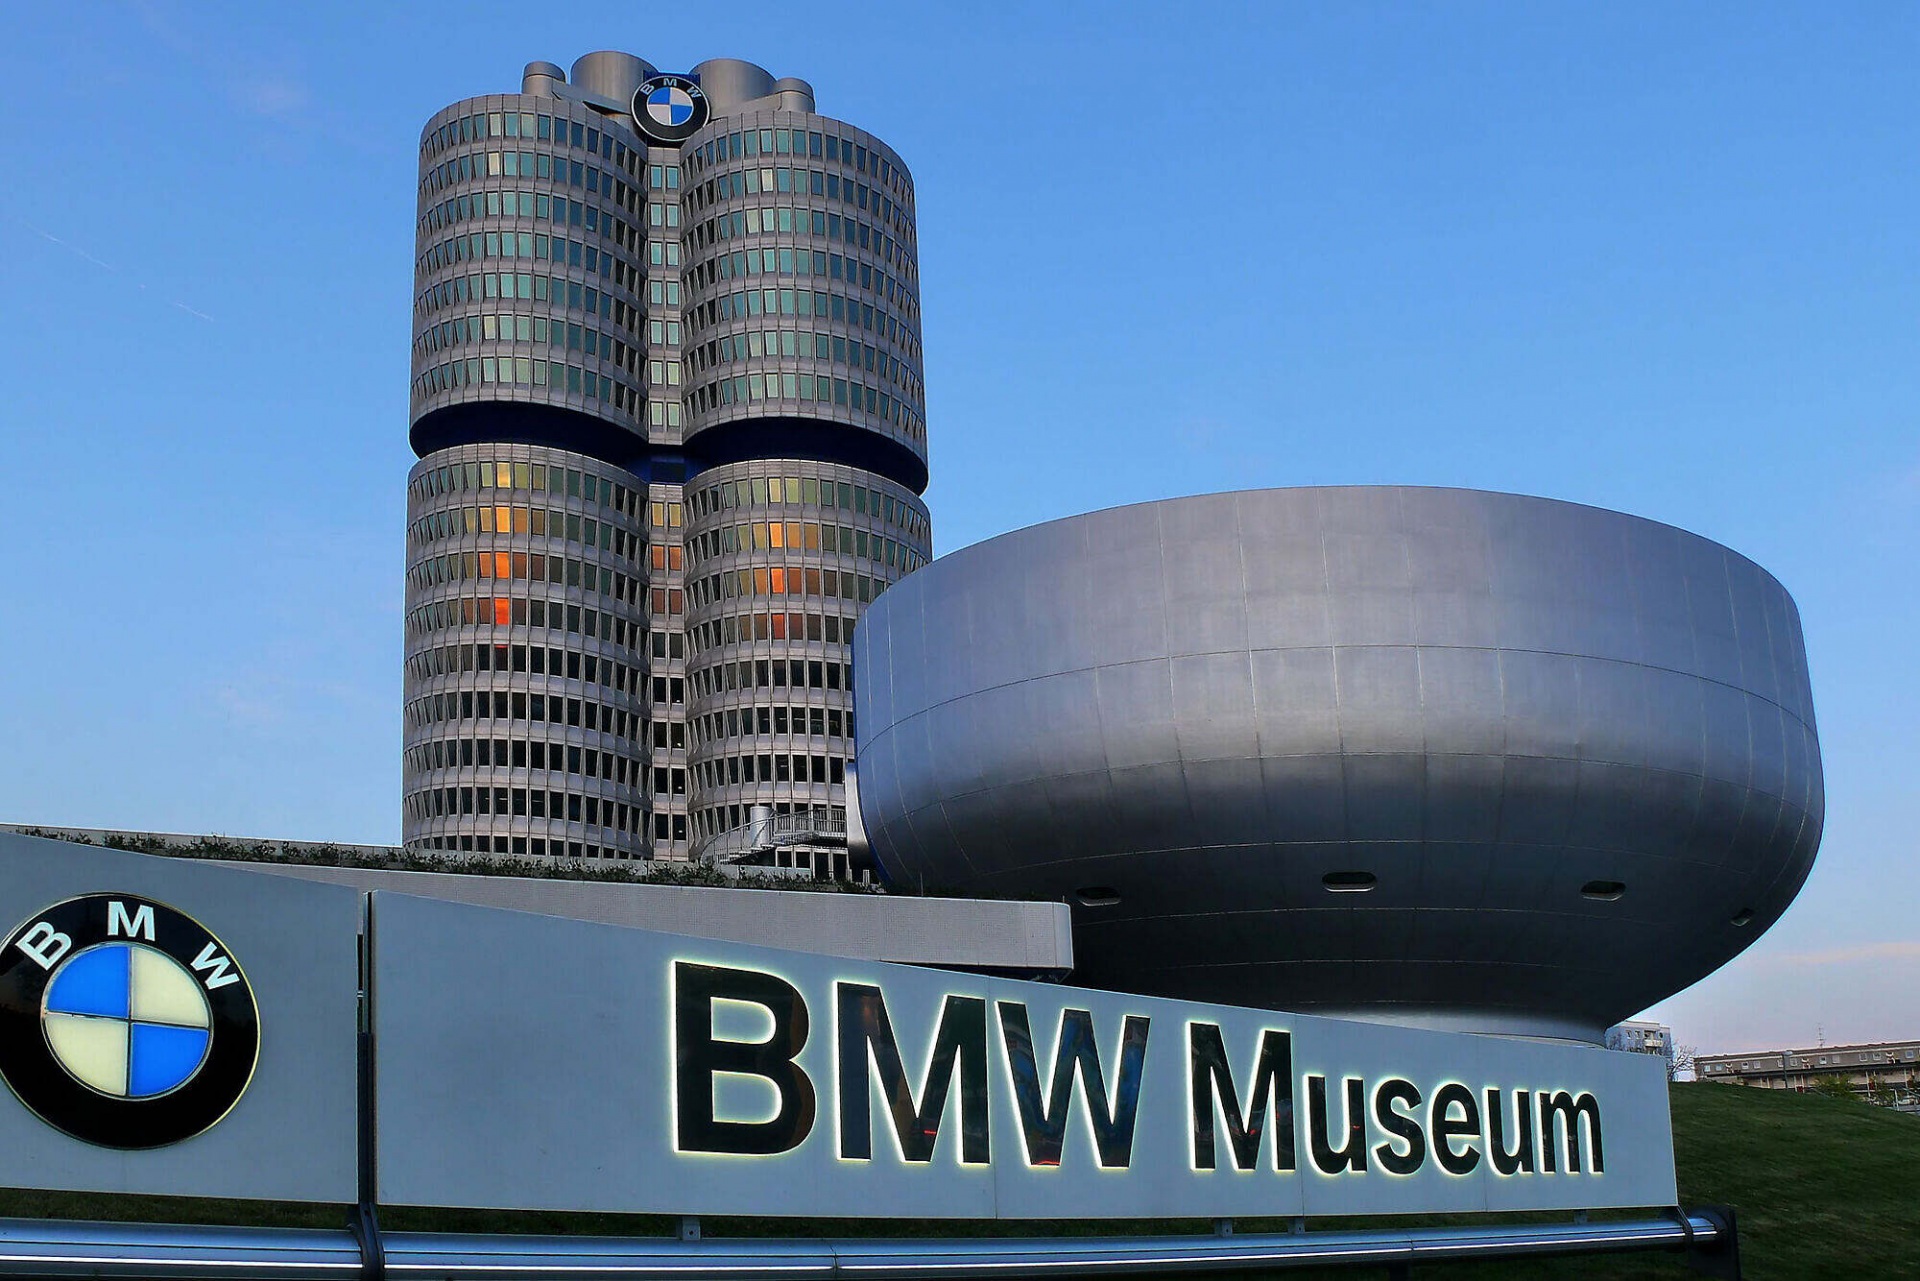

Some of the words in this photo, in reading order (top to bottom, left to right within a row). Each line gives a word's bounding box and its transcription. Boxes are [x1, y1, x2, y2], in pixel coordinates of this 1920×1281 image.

[640, 78, 702, 98] BMW
[15, 901, 240, 990] BMW
[672, 960, 1151, 1168] BMW
[1186, 1021, 1605, 1176] Museum
